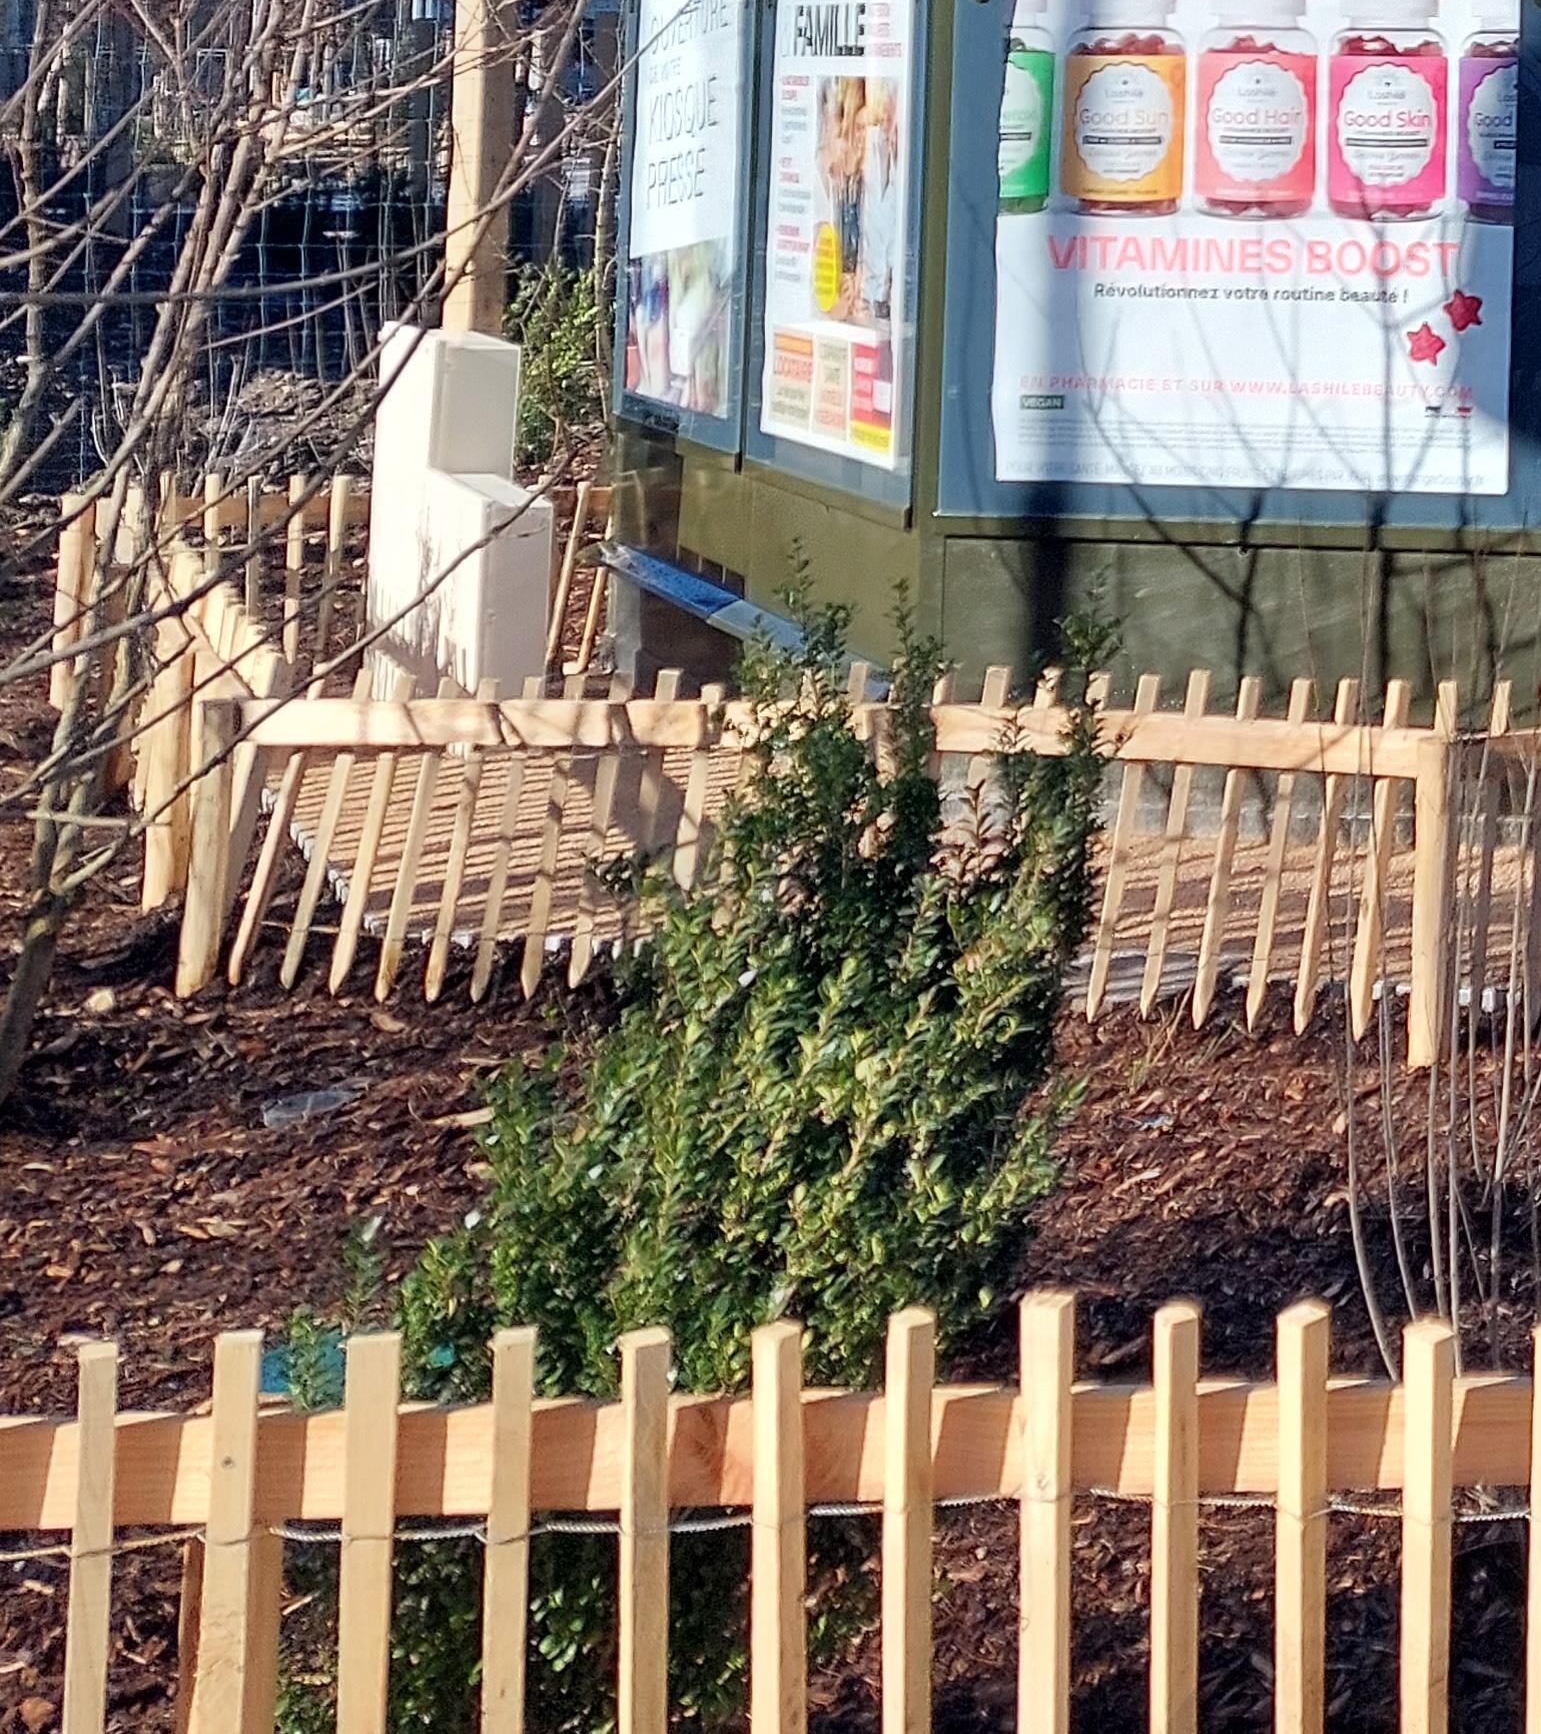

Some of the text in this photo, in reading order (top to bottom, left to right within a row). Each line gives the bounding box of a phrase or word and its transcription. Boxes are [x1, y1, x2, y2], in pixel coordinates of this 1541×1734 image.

[794, 3, 866, 57] FAMILLE
[649, 76, 719, 145] KIOSQUE
[1080, 108, 1169, 125] Good Sun
[1211, 105, 1302, 125] Good Hair
[1343, 109, 1430, 128] Good Skin
[647, 147, 706, 210] PRESSE
[1049, 235, 1461, 278] VITAMINES BOOST
[1094, 282, 1218, 299] Révolutionnez
[1224, 287, 1268, 300] votre
[1274, 286, 1335, 302] routine
[1340, 287, 1398, 303] beauté
[1051, 377, 1159, 391] PHARMACIE
[1163, 379, 1183, 391] ET
[1190, 379, 1224, 393] SUR
[1022, 397, 1062, 408] VEGAN
